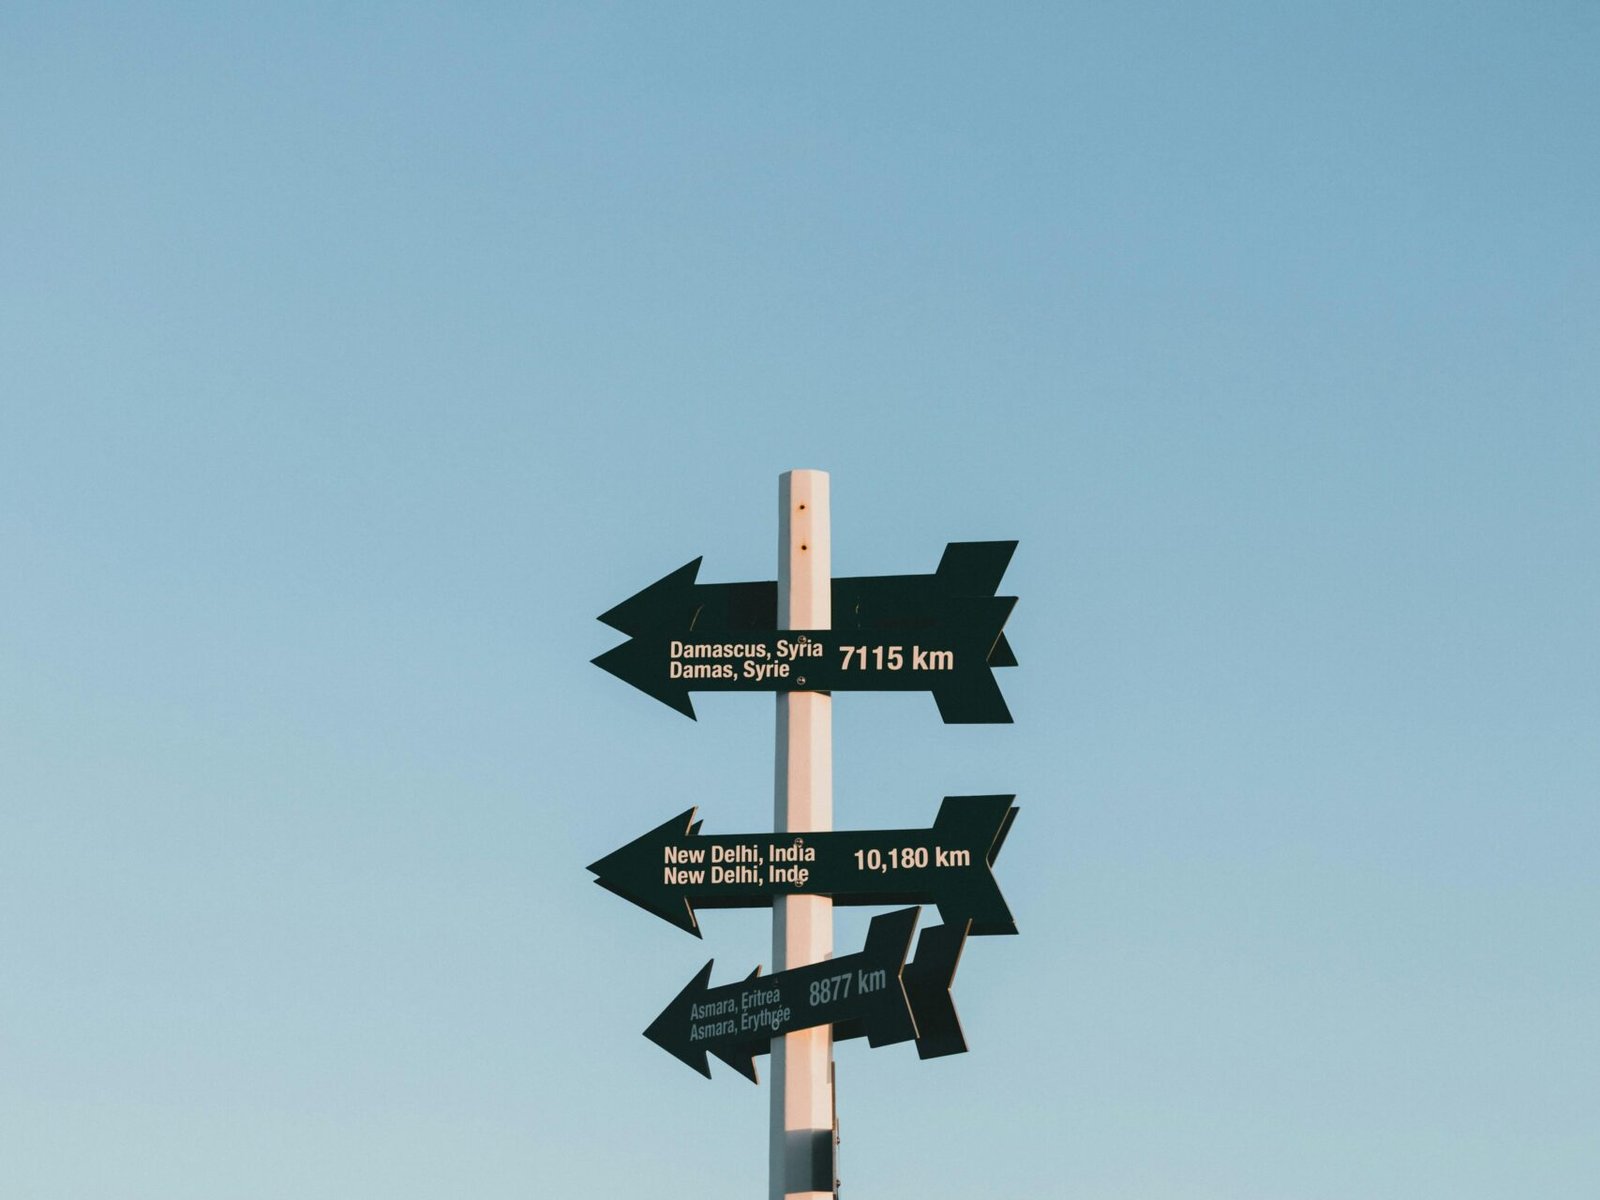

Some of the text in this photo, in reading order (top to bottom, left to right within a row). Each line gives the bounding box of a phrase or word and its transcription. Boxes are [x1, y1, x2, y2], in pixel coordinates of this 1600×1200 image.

[670, 639, 824, 660] Damascus, Syria
[839, 646, 954, 671] 7115 km
[670, 660, 790, 681] Damas, Syrie
[664, 844, 816, 866] New Delhi, India
[854, 846, 971, 874] 10,180 km
[664, 865, 809, 887] New Delhi, Inde
[809, 969, 886, 1007] 8877 km
[690, 989, 781, 1021] Asmara, Eritrea
[689, 1019, 738, 1041] Asmara,
